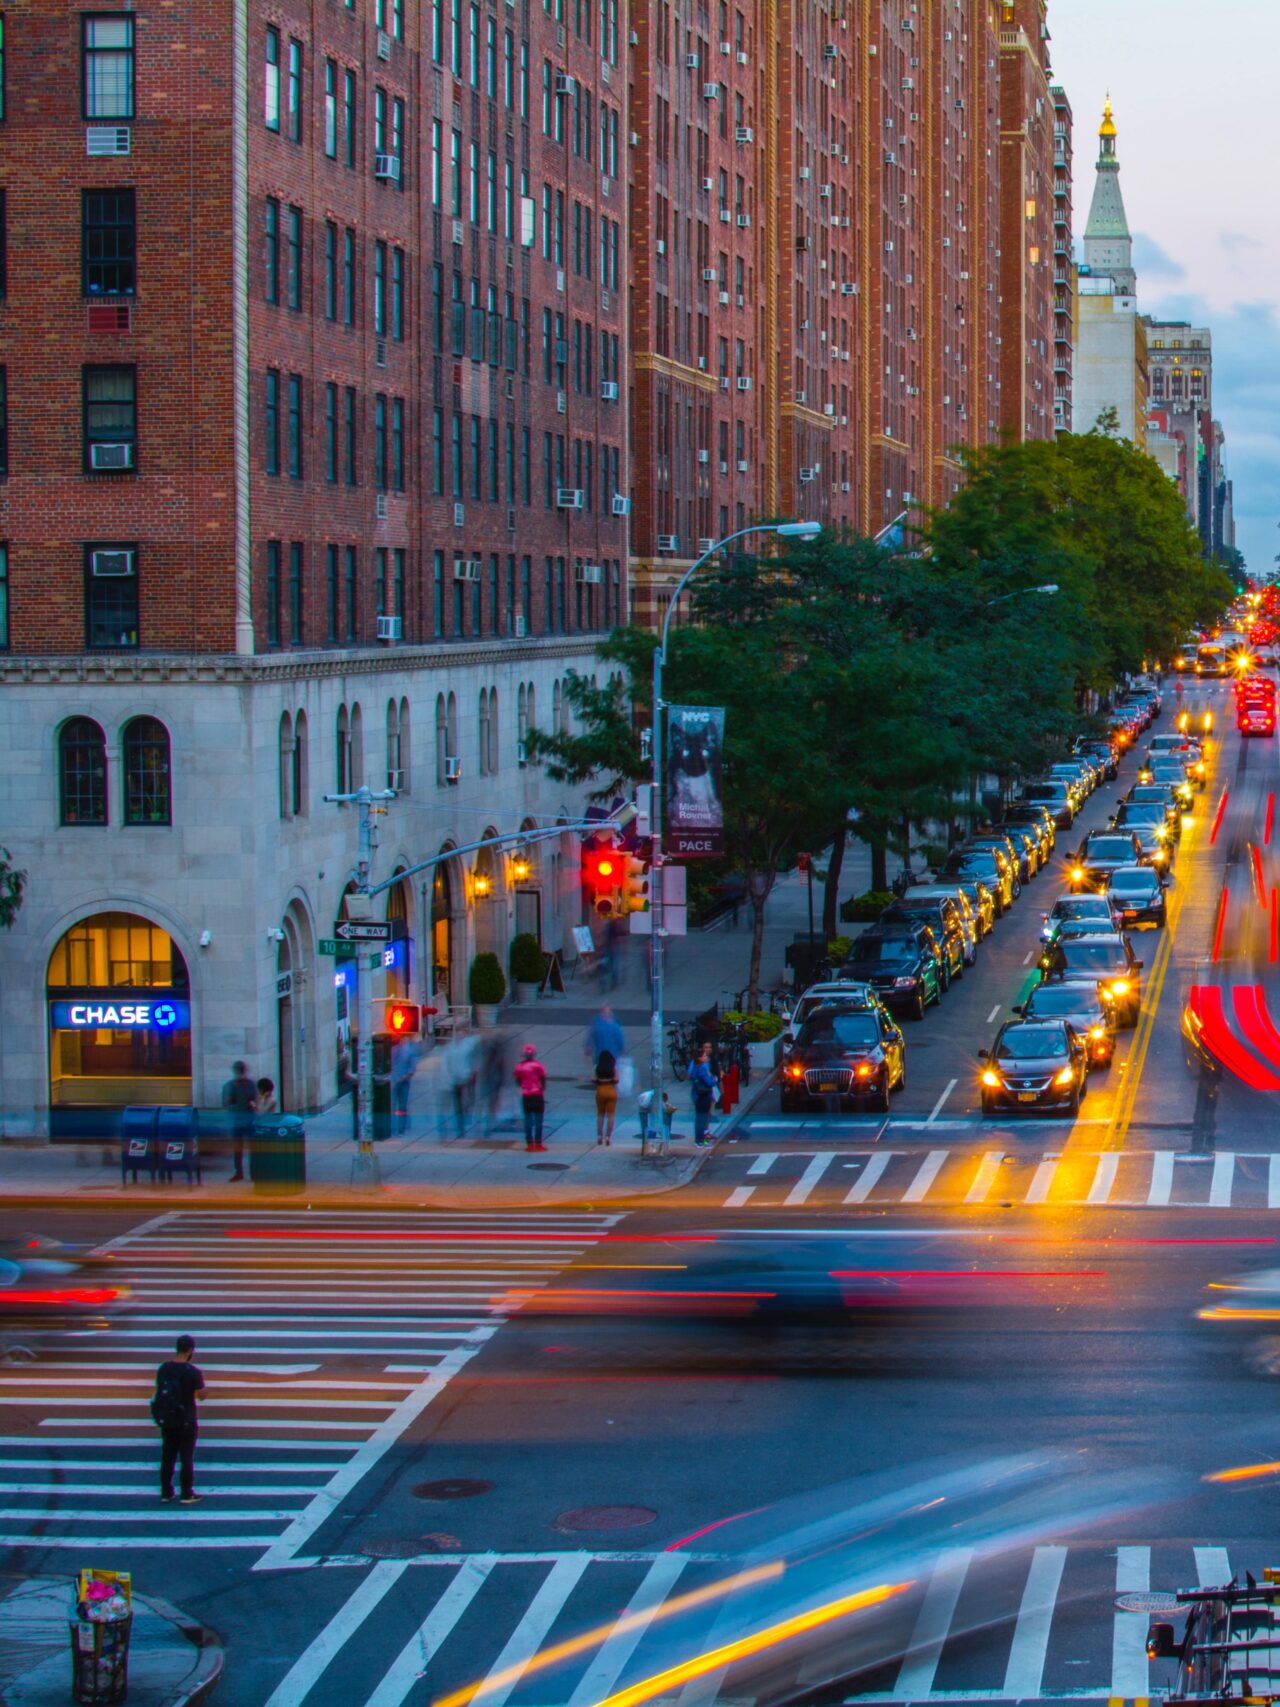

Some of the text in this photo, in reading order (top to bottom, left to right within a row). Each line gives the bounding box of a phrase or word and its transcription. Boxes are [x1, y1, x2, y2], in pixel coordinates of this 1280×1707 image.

[682, 711, 710, 722] NYC
[679, 840, 713, 851] PACE
[323, 941, 336, 953] 10
[70, 1006, 151, 1024] CHASE
